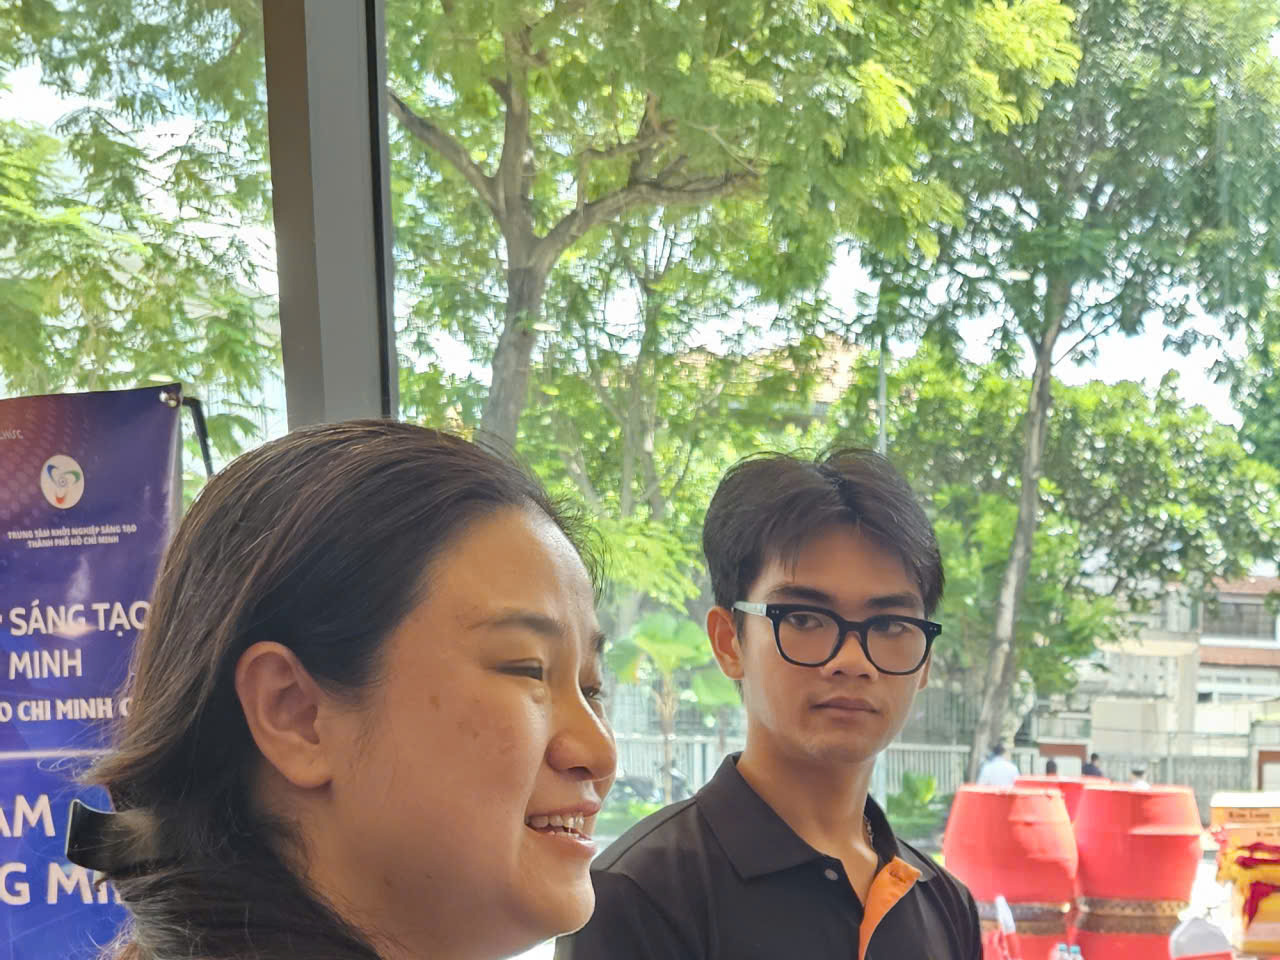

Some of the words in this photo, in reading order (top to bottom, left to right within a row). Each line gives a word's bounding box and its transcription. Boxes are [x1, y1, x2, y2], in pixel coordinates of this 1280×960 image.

[98, 536, 119, 544] MINH
[9, 599, 86, 636] SÁNG
[91, 601, 151, 637] TẠO
[9, 649, 82, 680] MINH
[17, 700, 51, 721] CHI
[56, 697, 113, 720] MINH
[47, 862, 125, 905] MI
